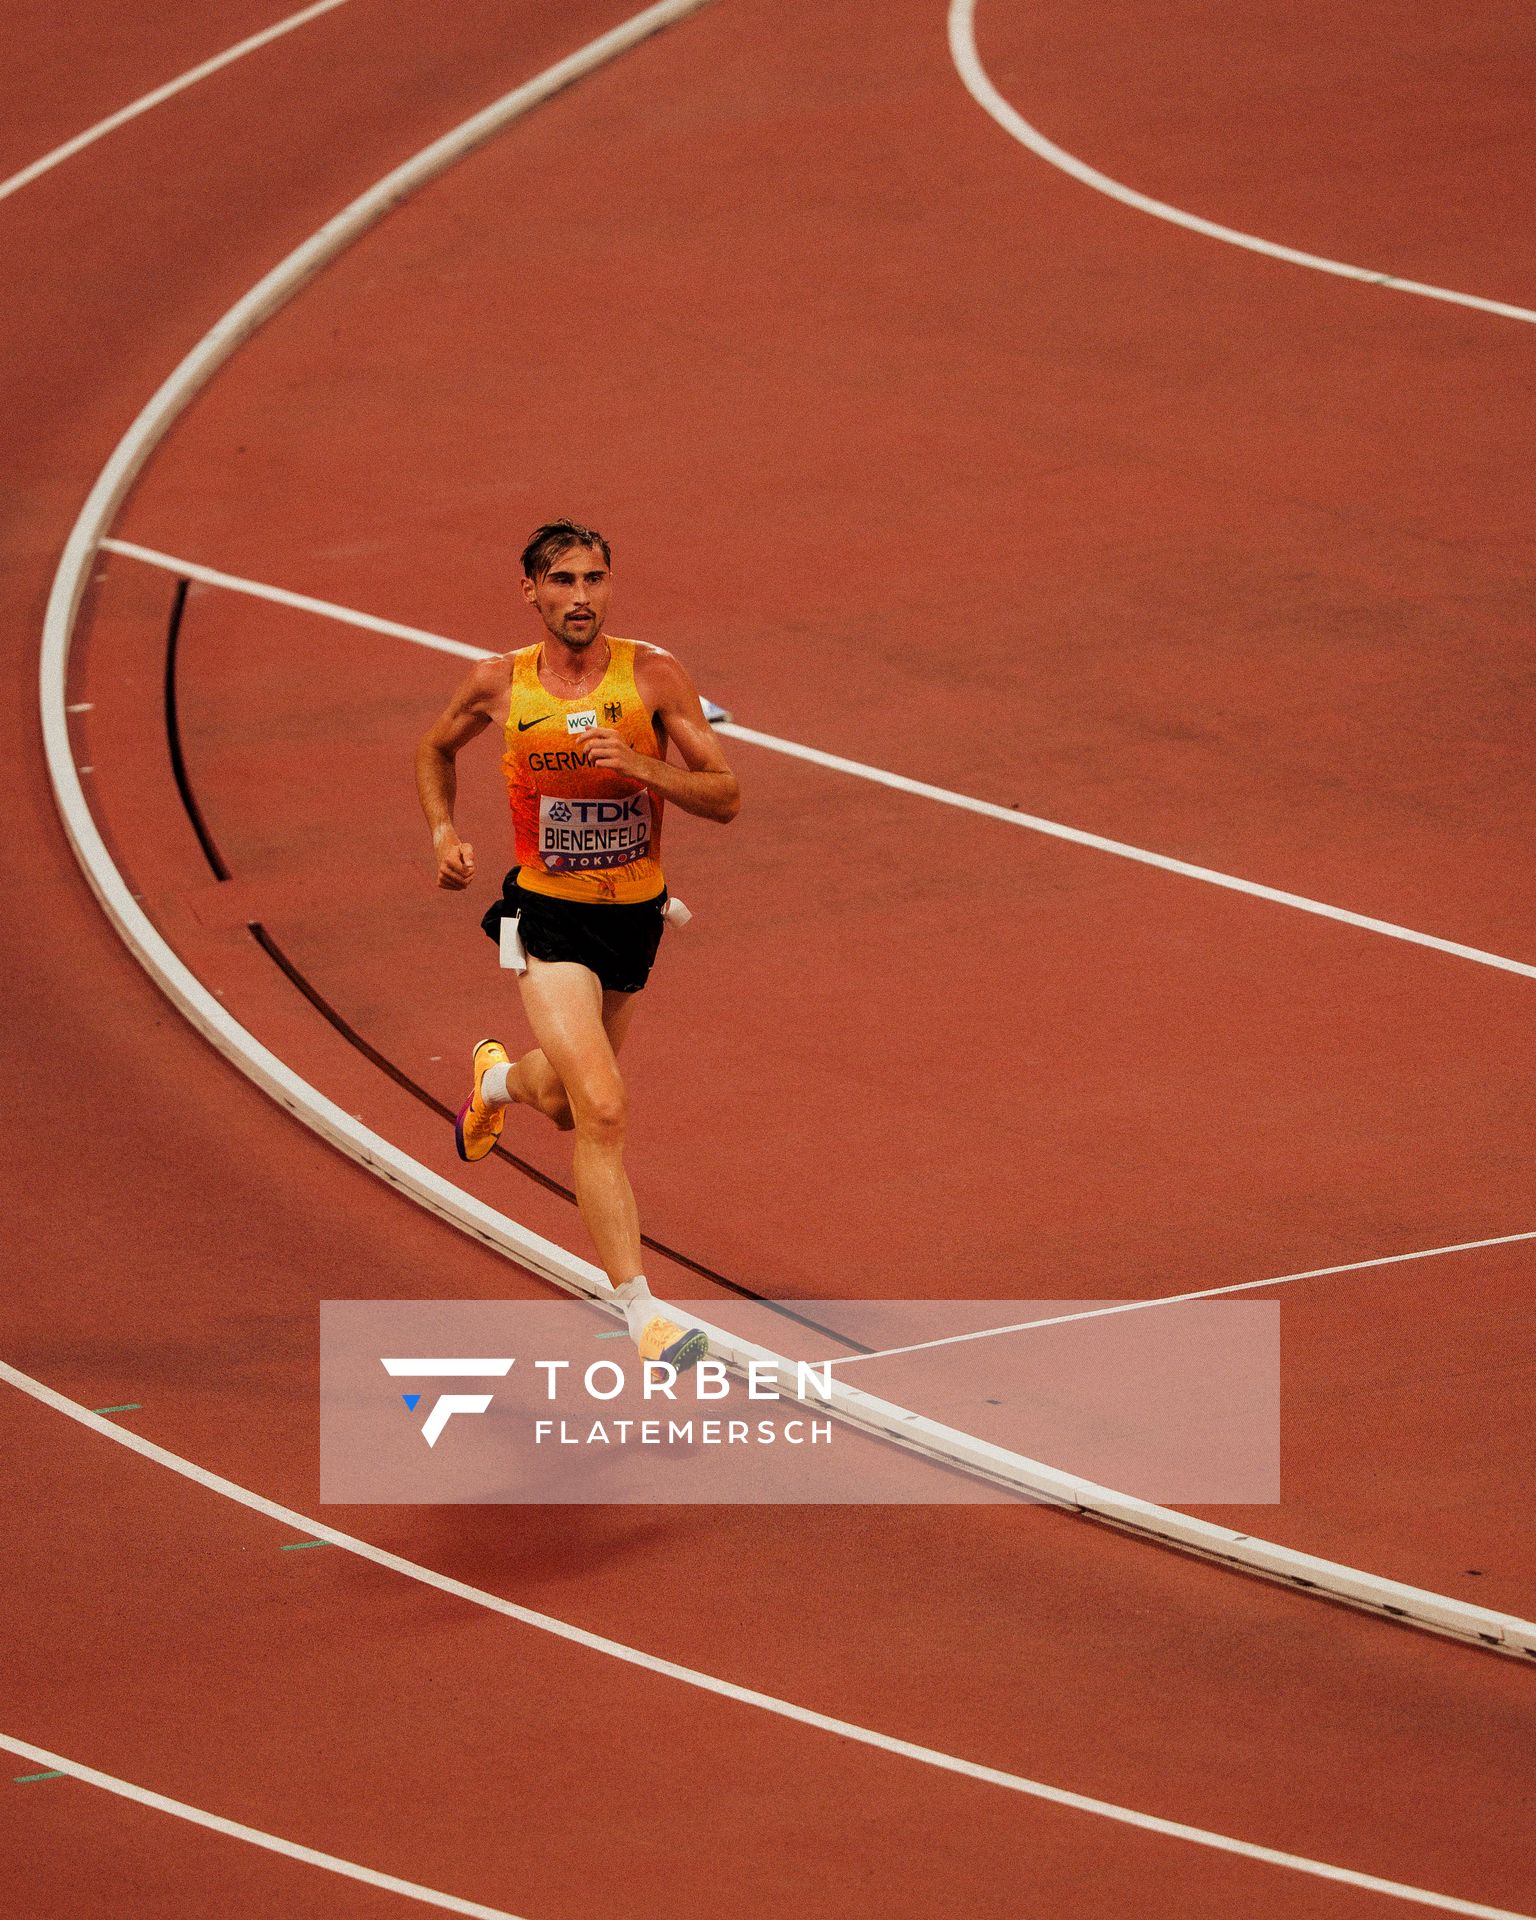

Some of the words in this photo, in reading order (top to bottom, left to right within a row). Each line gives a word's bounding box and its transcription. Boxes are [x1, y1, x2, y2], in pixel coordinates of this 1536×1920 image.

[568, 715, 595, 728] WGV
[529, 751, 596, 771] GERM
[572, 796, 643, 822] TDK
[545, 822, 646, 850] BIENENFELD
